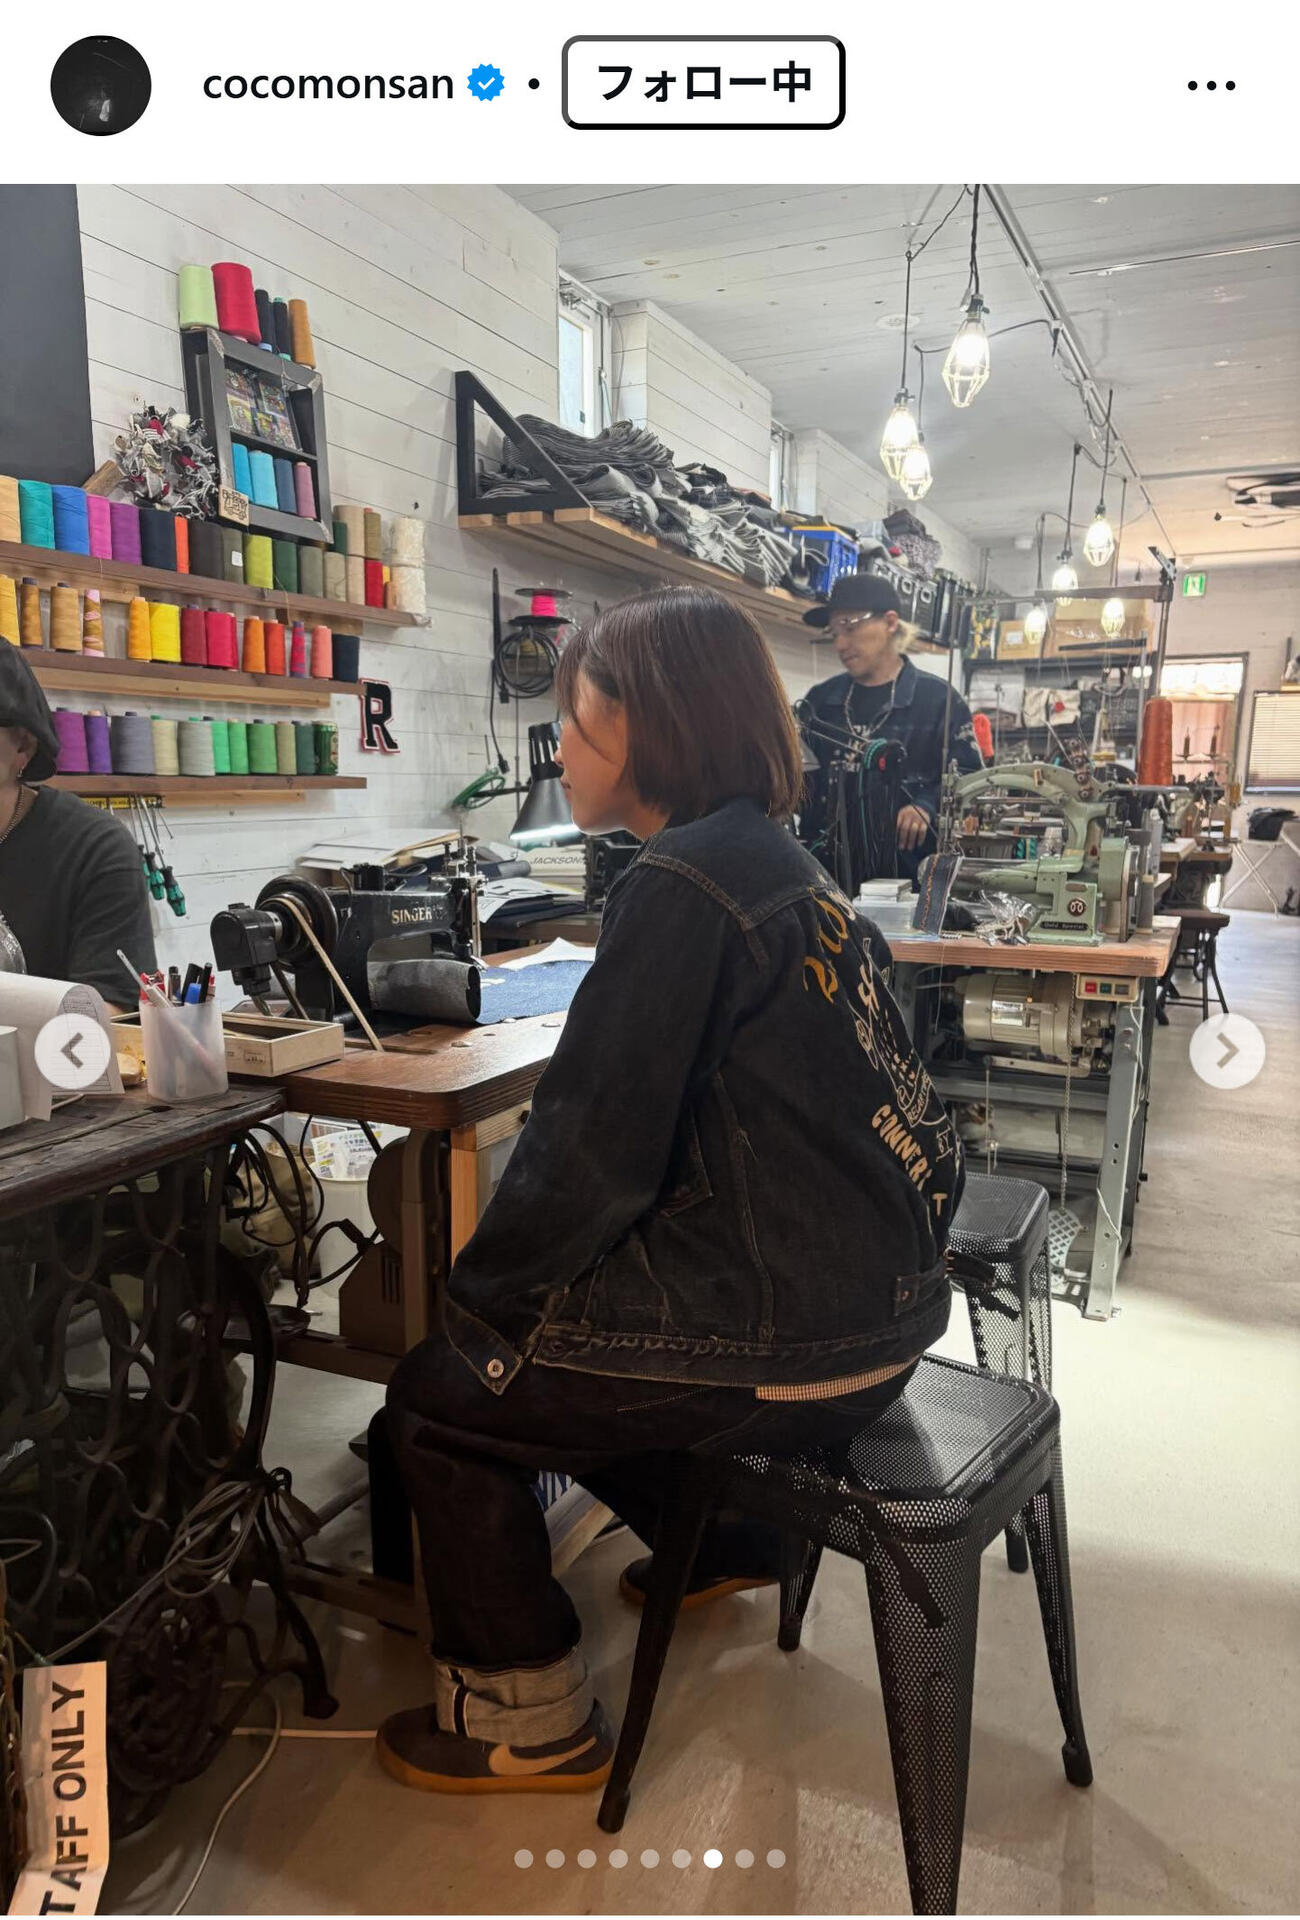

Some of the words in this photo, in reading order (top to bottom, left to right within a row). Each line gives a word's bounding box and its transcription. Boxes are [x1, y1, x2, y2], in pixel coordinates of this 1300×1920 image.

[359, 678, 401, 754] R
[391, 906, 432, 925] SINGER
[51, 1680, 87, 1802] ONLY
